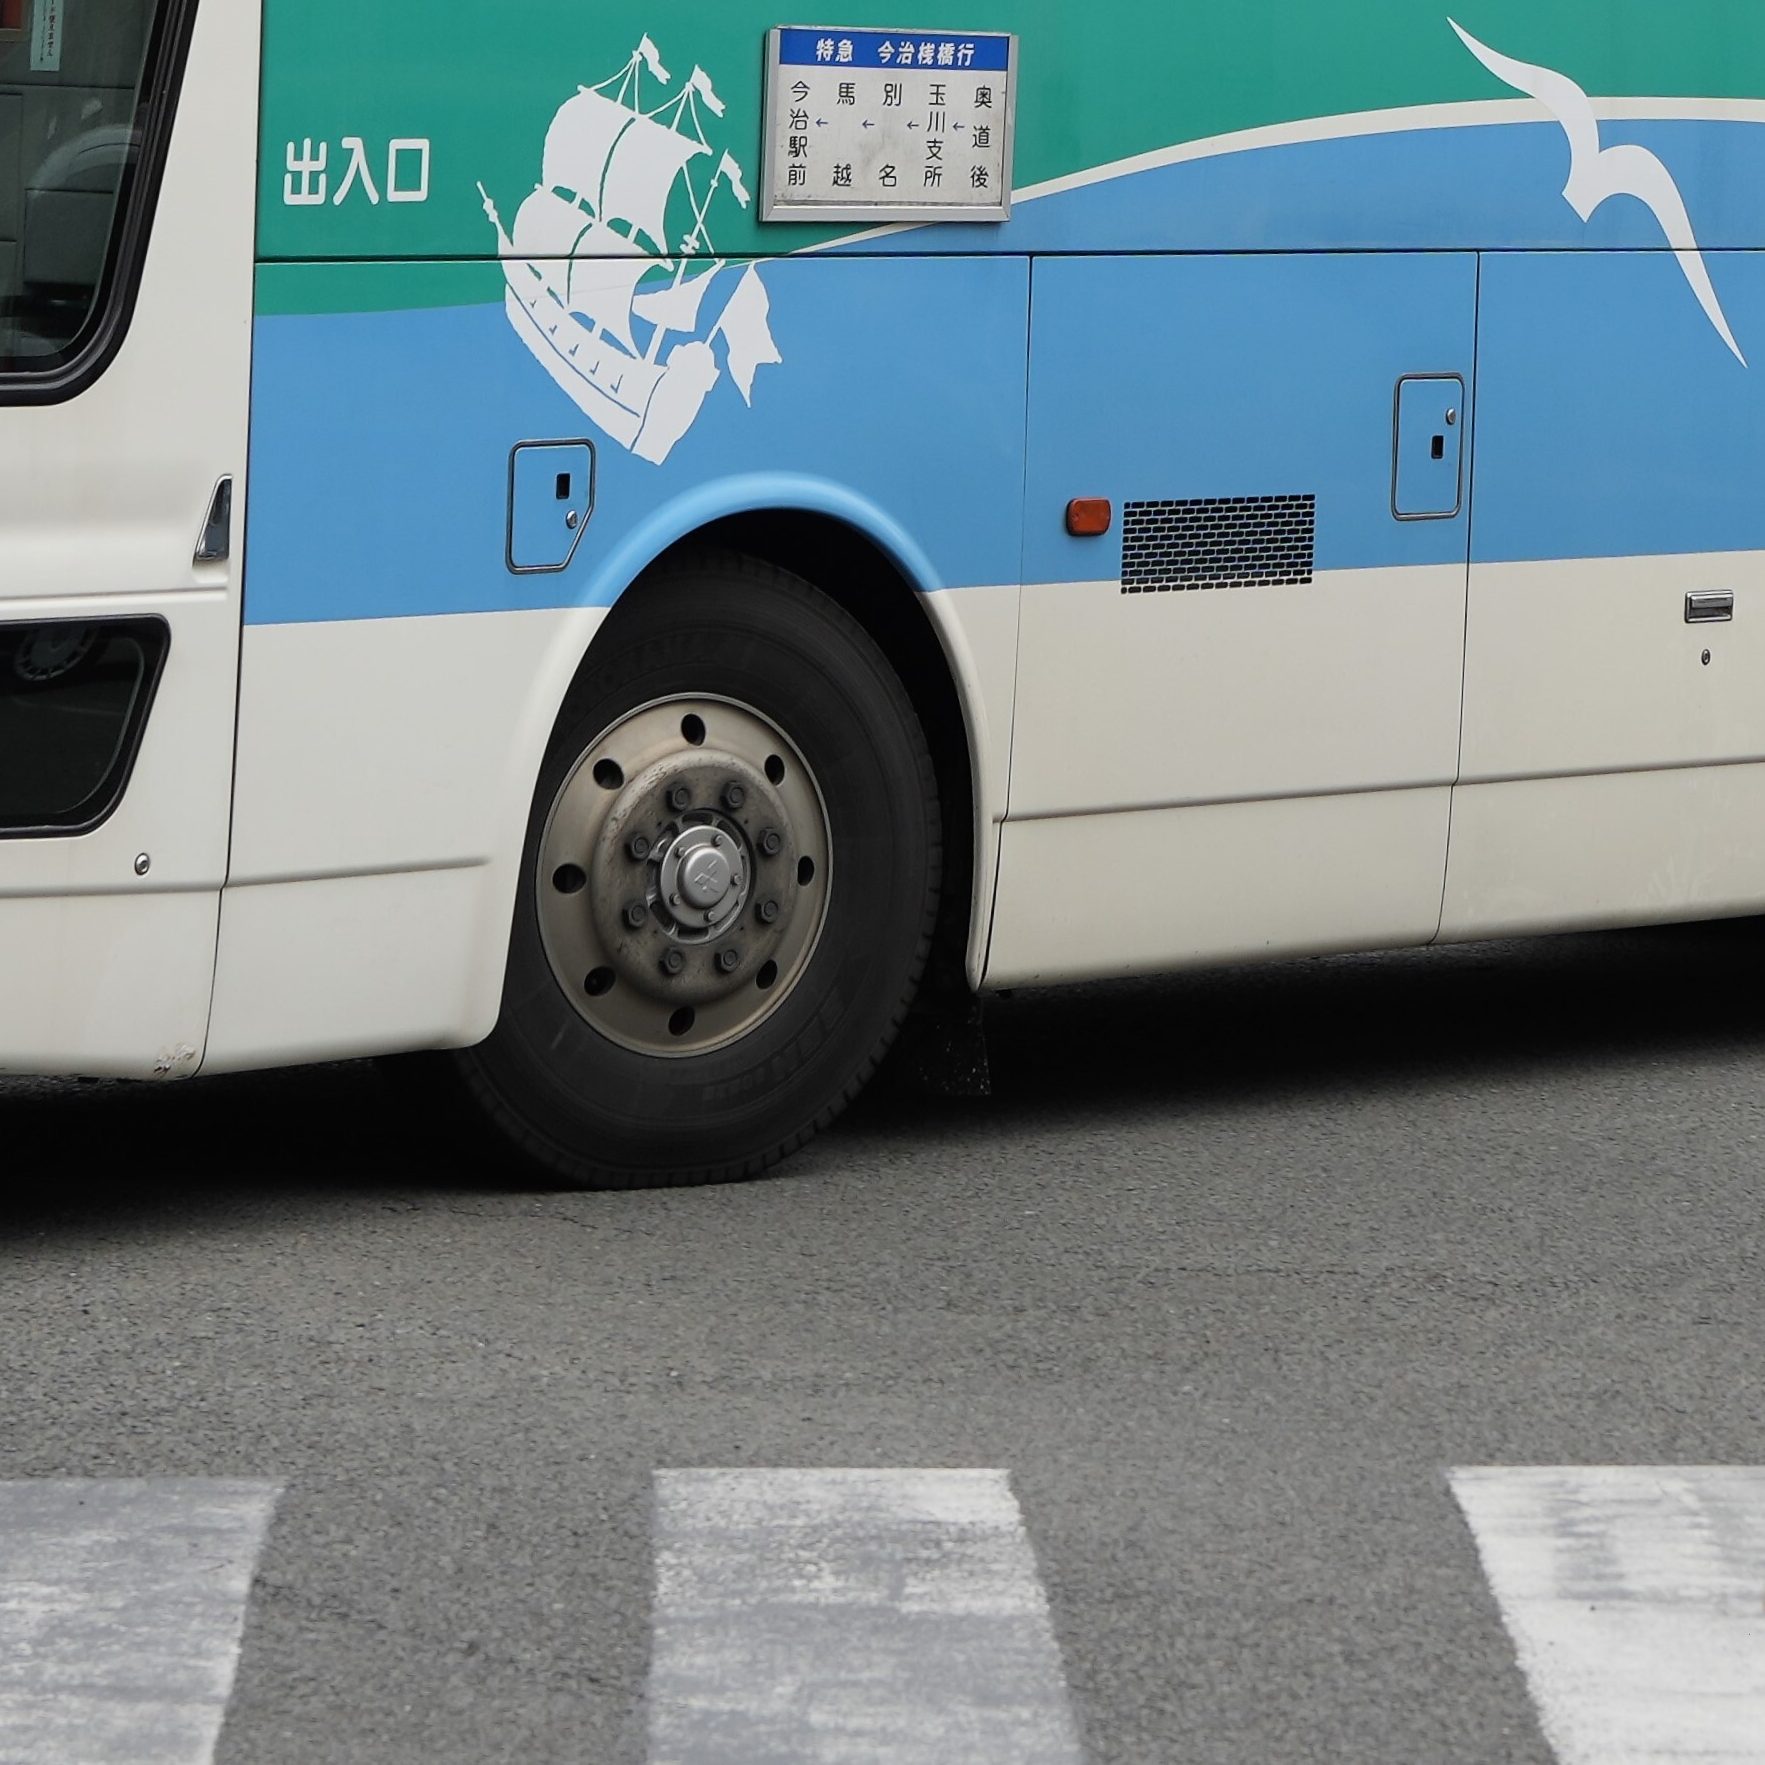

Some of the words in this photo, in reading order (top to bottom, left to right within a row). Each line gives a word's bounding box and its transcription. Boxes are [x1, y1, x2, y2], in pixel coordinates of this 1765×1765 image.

[815, 37, 855, 63] 特急
[877, 41, 976, 68] 今治桟橋行
[283, 136, 430, 206] 出入口
[787, 79, 811, 187] 今治駅前
[831, 82, 856, 188] 馬越
[878, 82, 903, 188] 別名
[923, 83, 947, 188] 玉川支所
[969, 84, 993, 189] 奥道後
